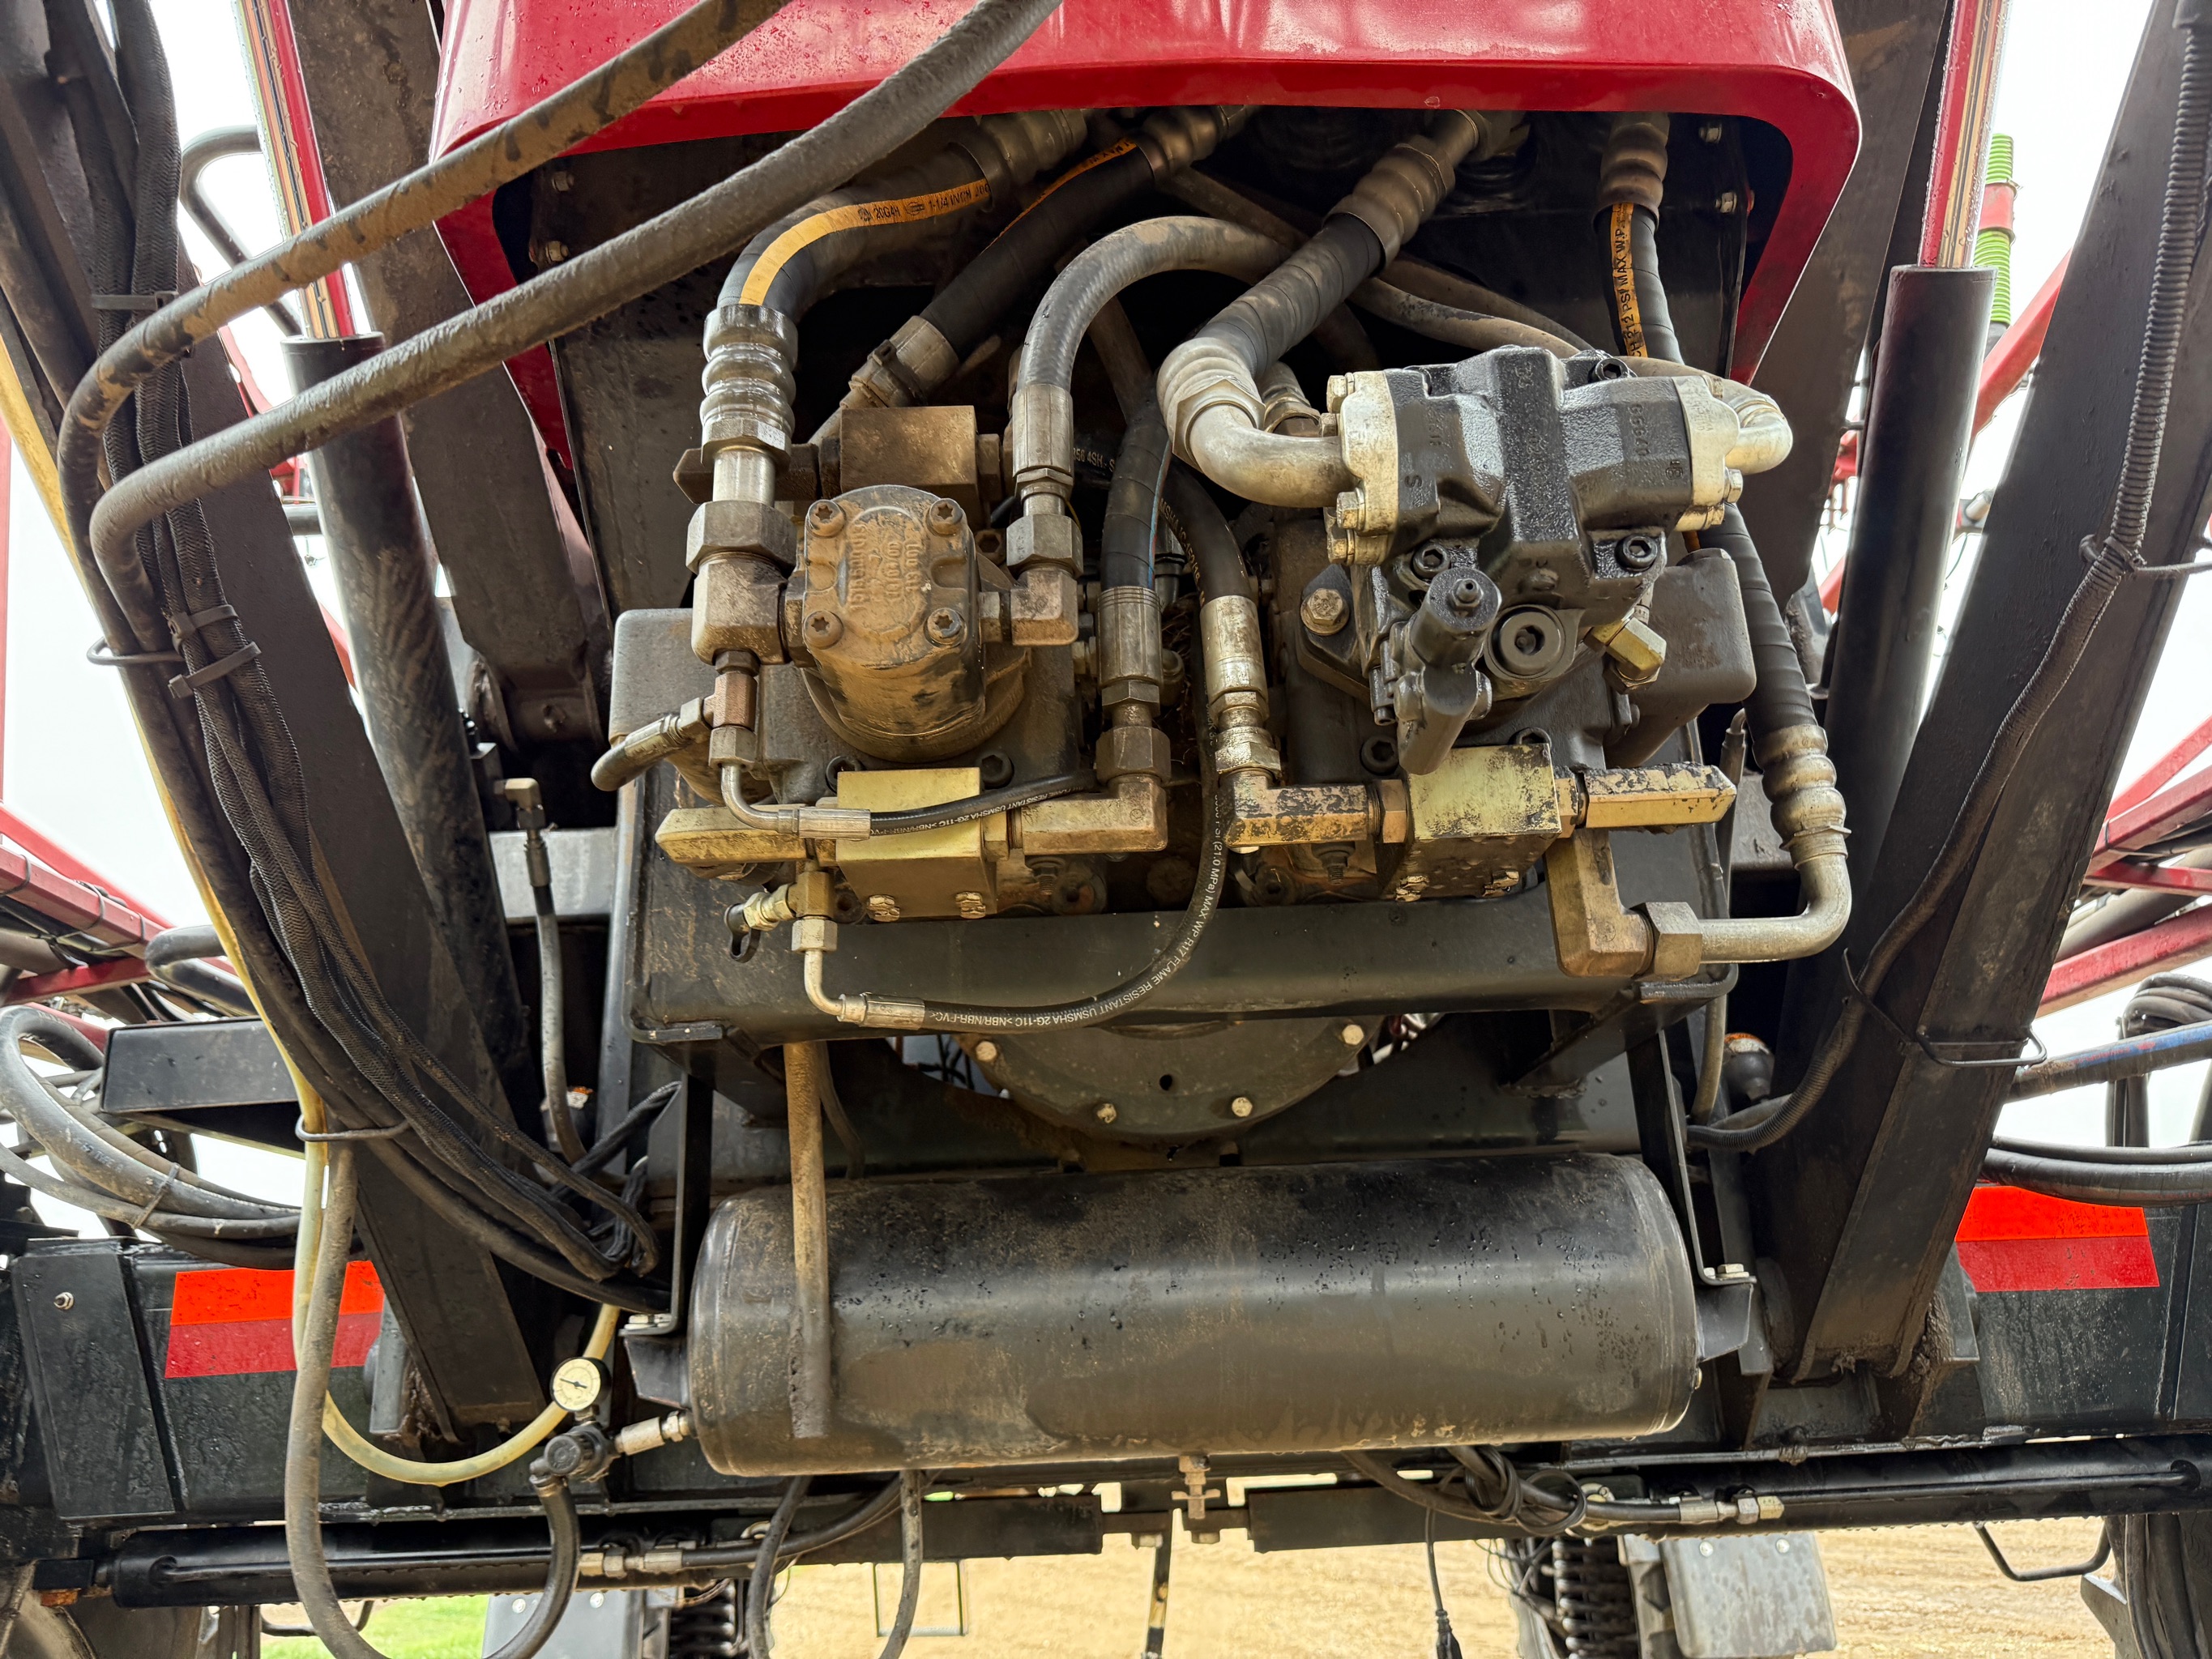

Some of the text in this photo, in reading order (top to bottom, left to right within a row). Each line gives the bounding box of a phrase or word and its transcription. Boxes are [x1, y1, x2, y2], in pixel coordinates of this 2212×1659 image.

[1613, 255, 1629, 287] MAX
[1617, 288, 1633, 313] PSI
[1212, 841, 1223, 866] (21.0
[1208, 867, 1220, 894] MPa)
[1198, 894, 1214, 919] MAX
[1193, 920, 1204, 938] WP
[1179, 937, 1194, 957] R17
[1151, 955, 1181, 984] FLAME
[1100, 981, 1152, 1011] RESISTANT
[1015, 1016, 1051, 1027] 2G-11C
[1053, 1008, 1097, 1025] USMSHA
